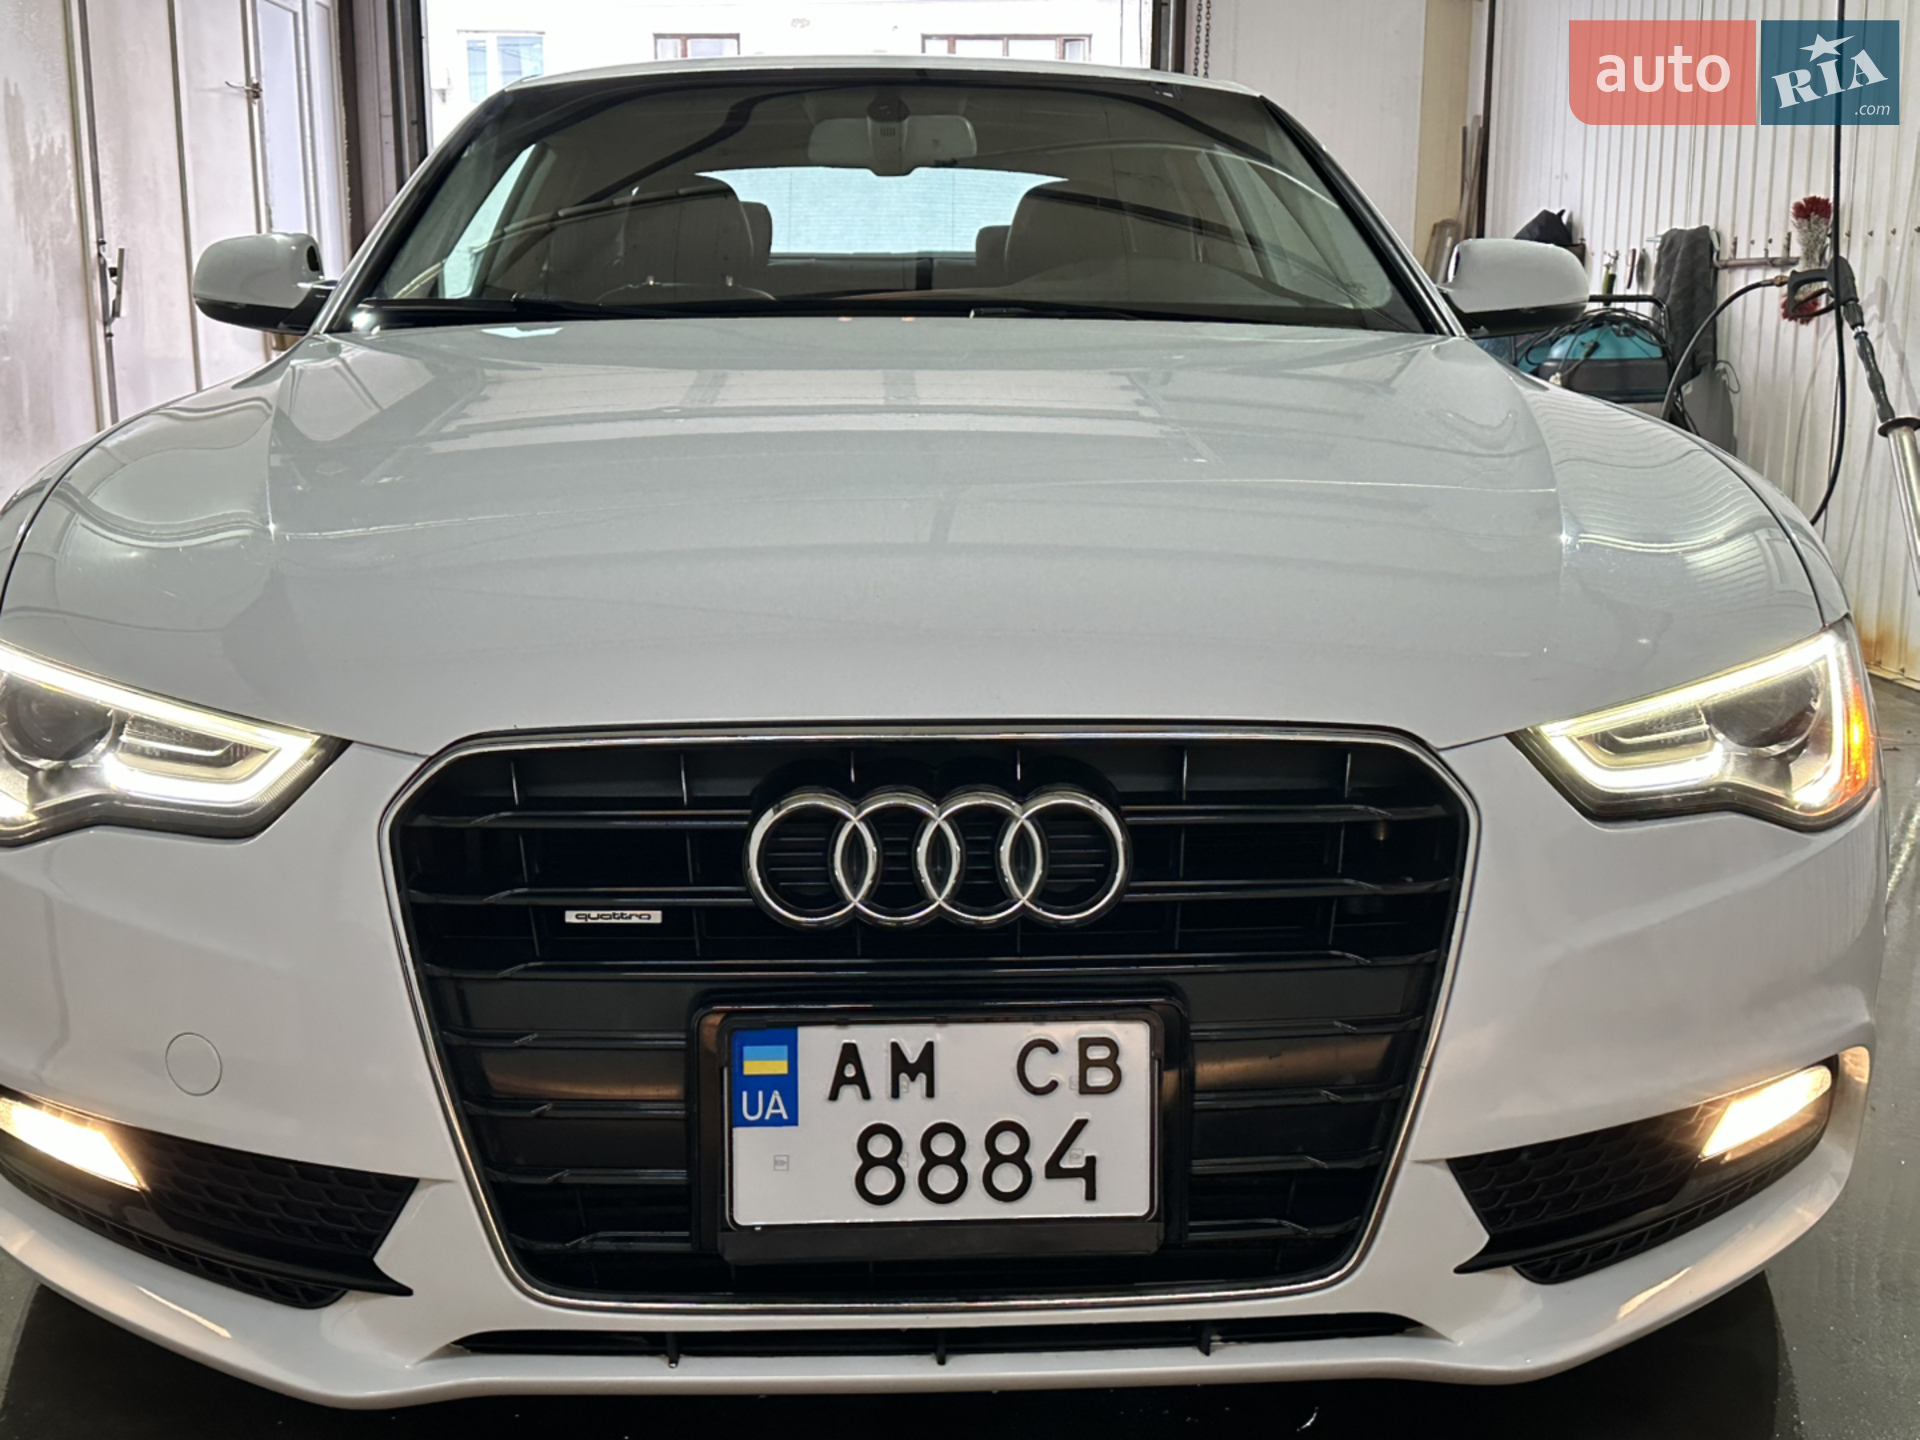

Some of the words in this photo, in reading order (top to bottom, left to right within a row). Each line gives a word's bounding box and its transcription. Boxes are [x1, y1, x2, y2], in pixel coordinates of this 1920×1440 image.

[574, 911, 652, 922] quattro
[827, 1039, 936, 1101] AM
[1015, 1036, 1123, 1096] CB
[740, 1089, 790, 1121] UA
[854, 1117, 1097, 1206] 8884
